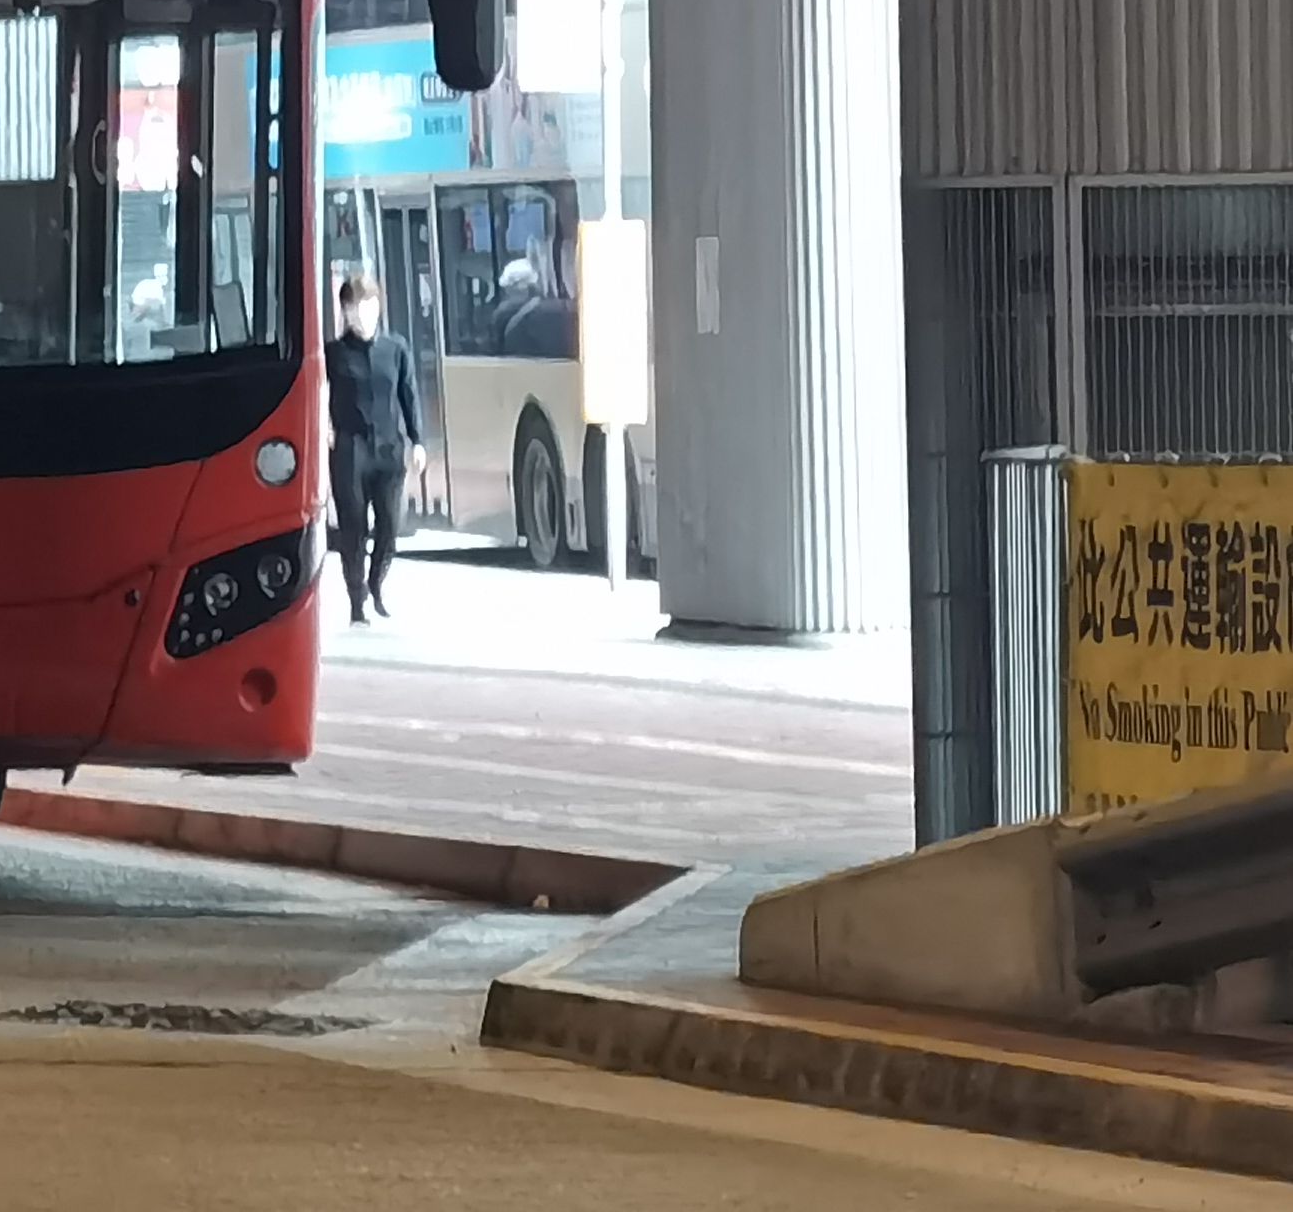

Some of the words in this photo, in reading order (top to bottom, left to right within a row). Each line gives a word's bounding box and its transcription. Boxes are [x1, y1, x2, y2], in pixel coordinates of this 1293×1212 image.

[1077, 518, 1293, 654] 此公共運輸設
[1104, 681, 1182, 764] Smoking
[1184, 685, 1203, 748] in
[1207, 686, 1238, 750] this
